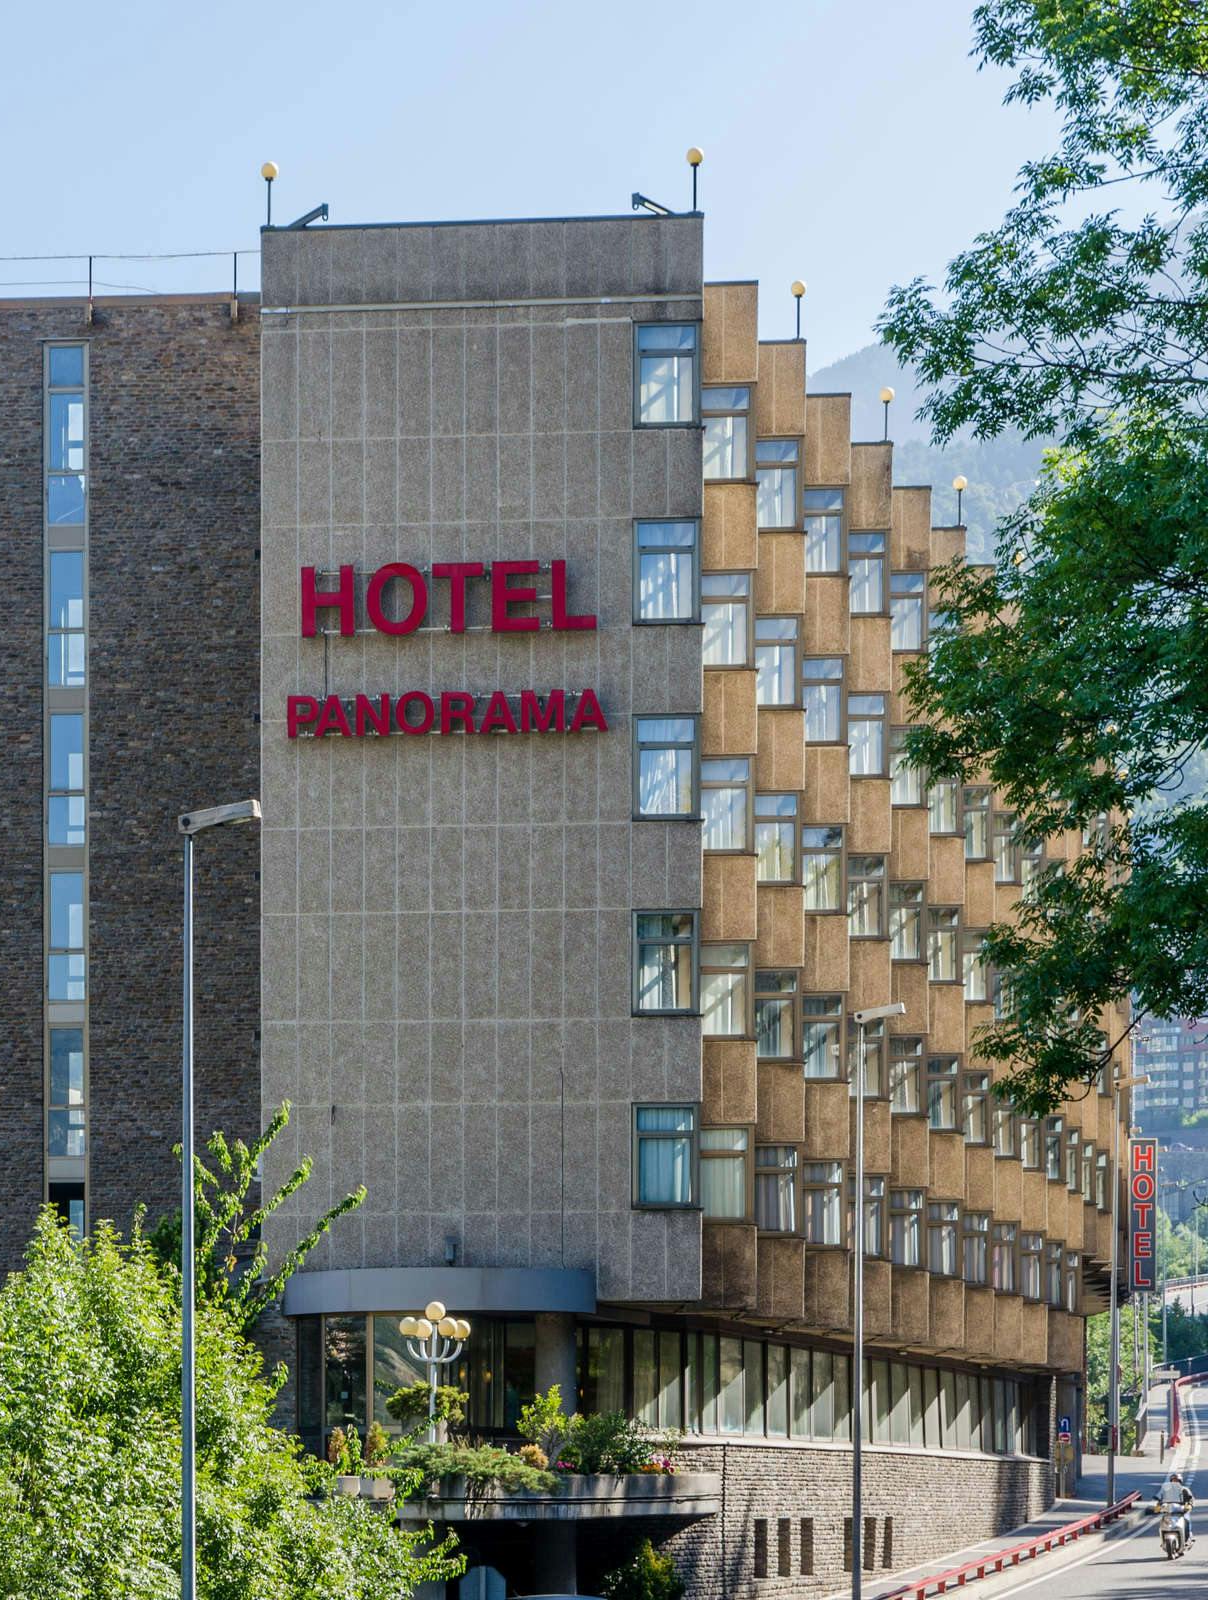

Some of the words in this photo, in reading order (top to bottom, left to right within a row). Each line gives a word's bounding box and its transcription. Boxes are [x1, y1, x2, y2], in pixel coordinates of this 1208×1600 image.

[301, 560, 597, 638] HOTEL
[287, 688, 609, 738] PANORAMA
[1132, 1145, 1154, 1286] HOTEL
